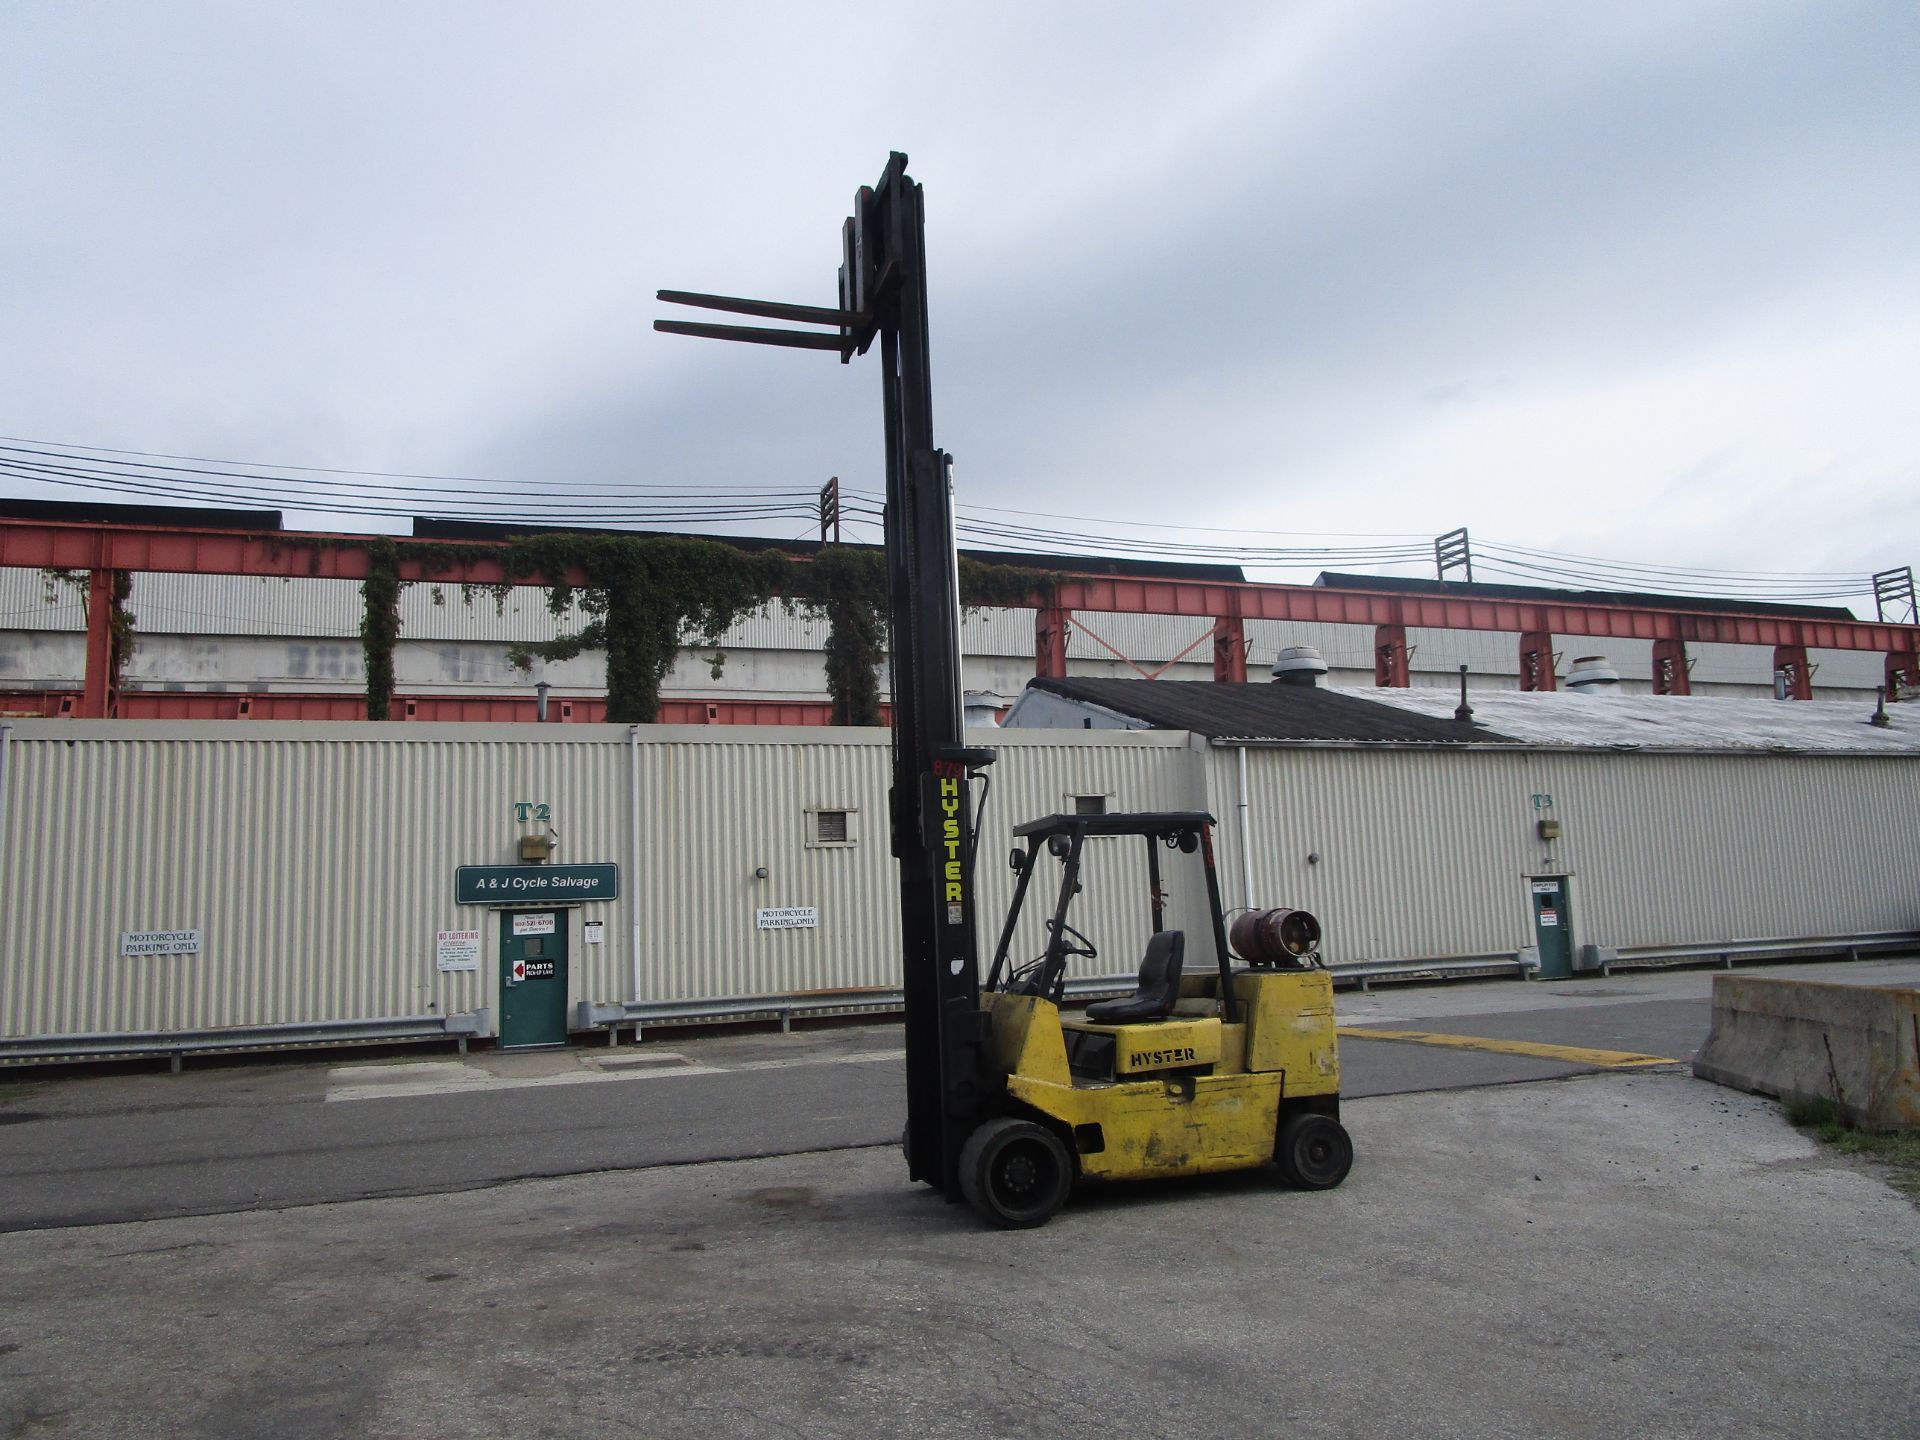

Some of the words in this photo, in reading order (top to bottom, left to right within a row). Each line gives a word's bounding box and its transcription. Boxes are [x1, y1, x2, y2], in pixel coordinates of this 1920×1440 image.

[1531, 794, 1553, 809] T3
[941, 778, 962, 901] HYSTER
[476, 879, 485, 889] A
[489, 879, 498, 889] &
[501, 878, 509, 888] J
[513, 877, 547, 891] Cycle
[551, 876, 599, 889] Salvage
[129, 933, 195, 942] MOTORCYCLE
[438, 932, 447, 940] NO
[449, 931, 479, 940] LOITERING
[126, 943, 169, 952] PARKING
[173, 942, 198, 950] ONLY
[1131, 1047, 1195, 1066] HYSTER
